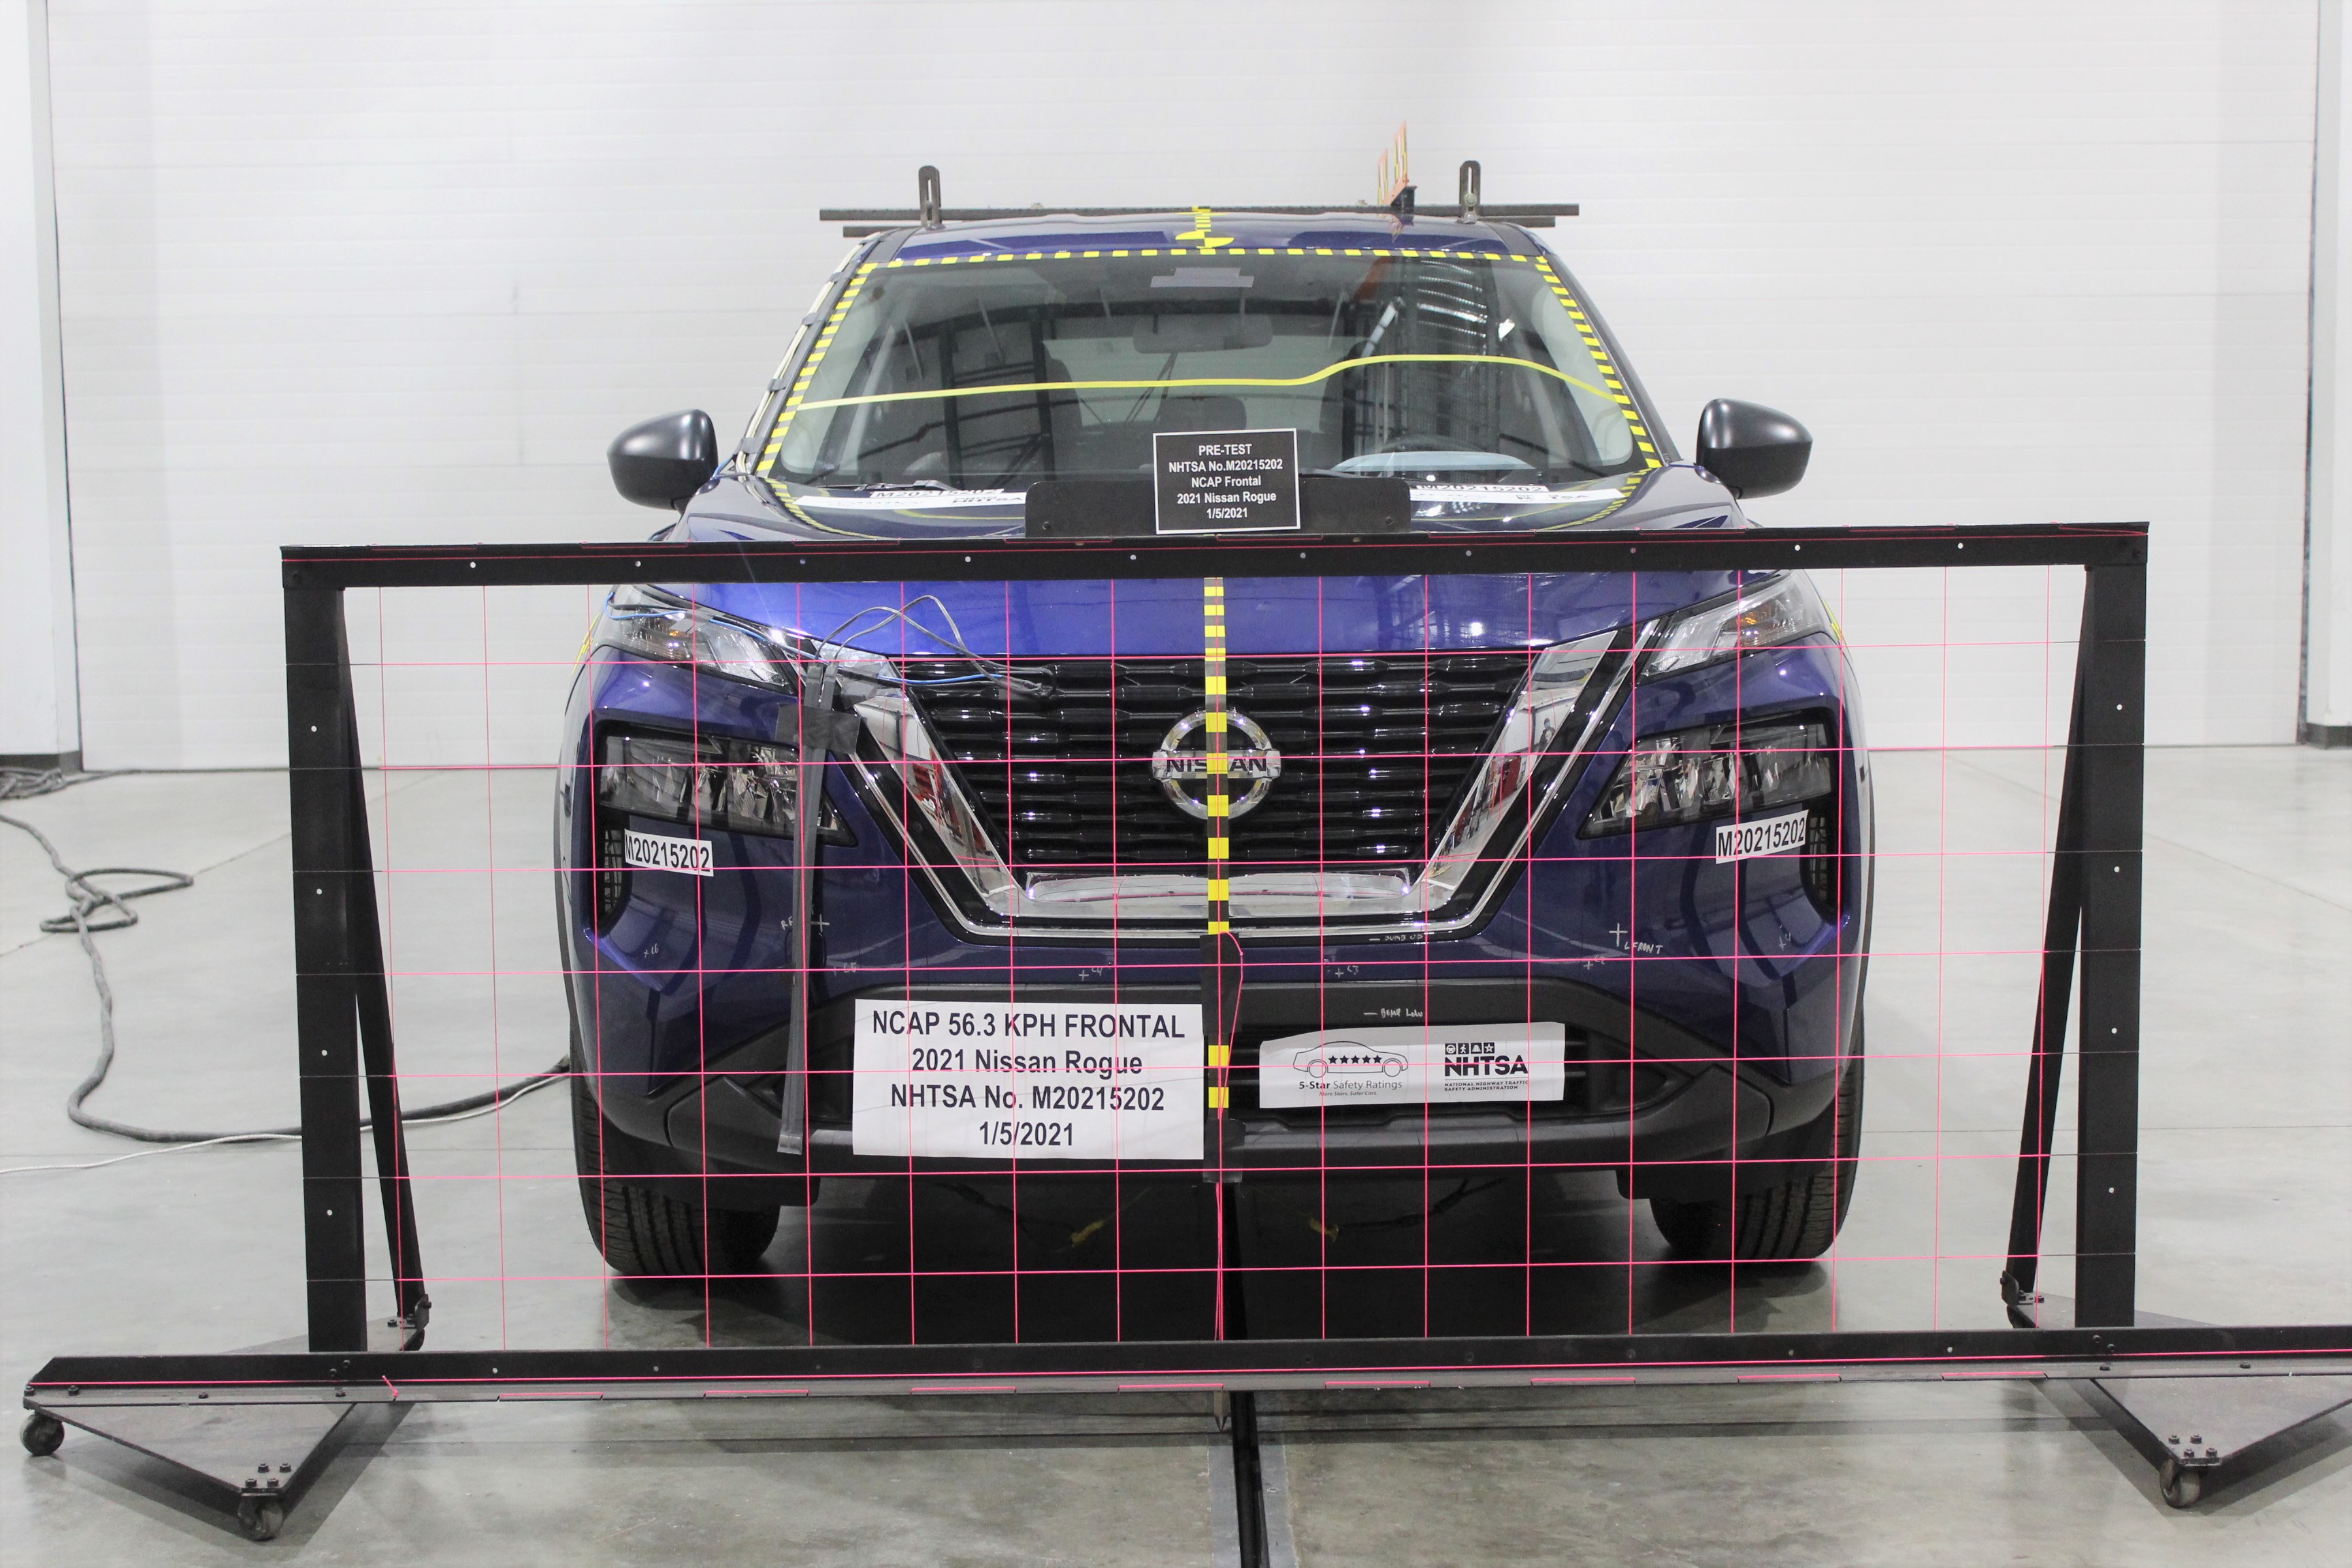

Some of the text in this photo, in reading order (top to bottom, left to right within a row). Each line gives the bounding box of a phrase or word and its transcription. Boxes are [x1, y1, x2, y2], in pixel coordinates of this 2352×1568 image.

[1198, 444, 1252, 456] PRE-TEST
[1169, 459, 1283, 473] NHTSA No.M20215202
[1191, 475, 1261, 488] NCAP Frontal
[1177, 491, 1277, 504] 2021 Nissan Rogue
[1207, 507, 1247, 519] 1/5/2021
[1718, 817, 1805, 858] M20215202
[625, 834, 710, 872] M20215202
[872, 1010, 1185, 1039] NCAP 56.3 KPH FRONTAL
[912, 1047, 1143, 1081] 2021 Nissan Rogue
[1444, 1054, 1529, 1077] NHTSA
[1298, 1080, 1403, 1090] 5-Star Safety Ratings
[891, 1083, 1164, 1111] NHTSA No. M20215202
[979, 1121, 1074, 1147] 1/5/2021
